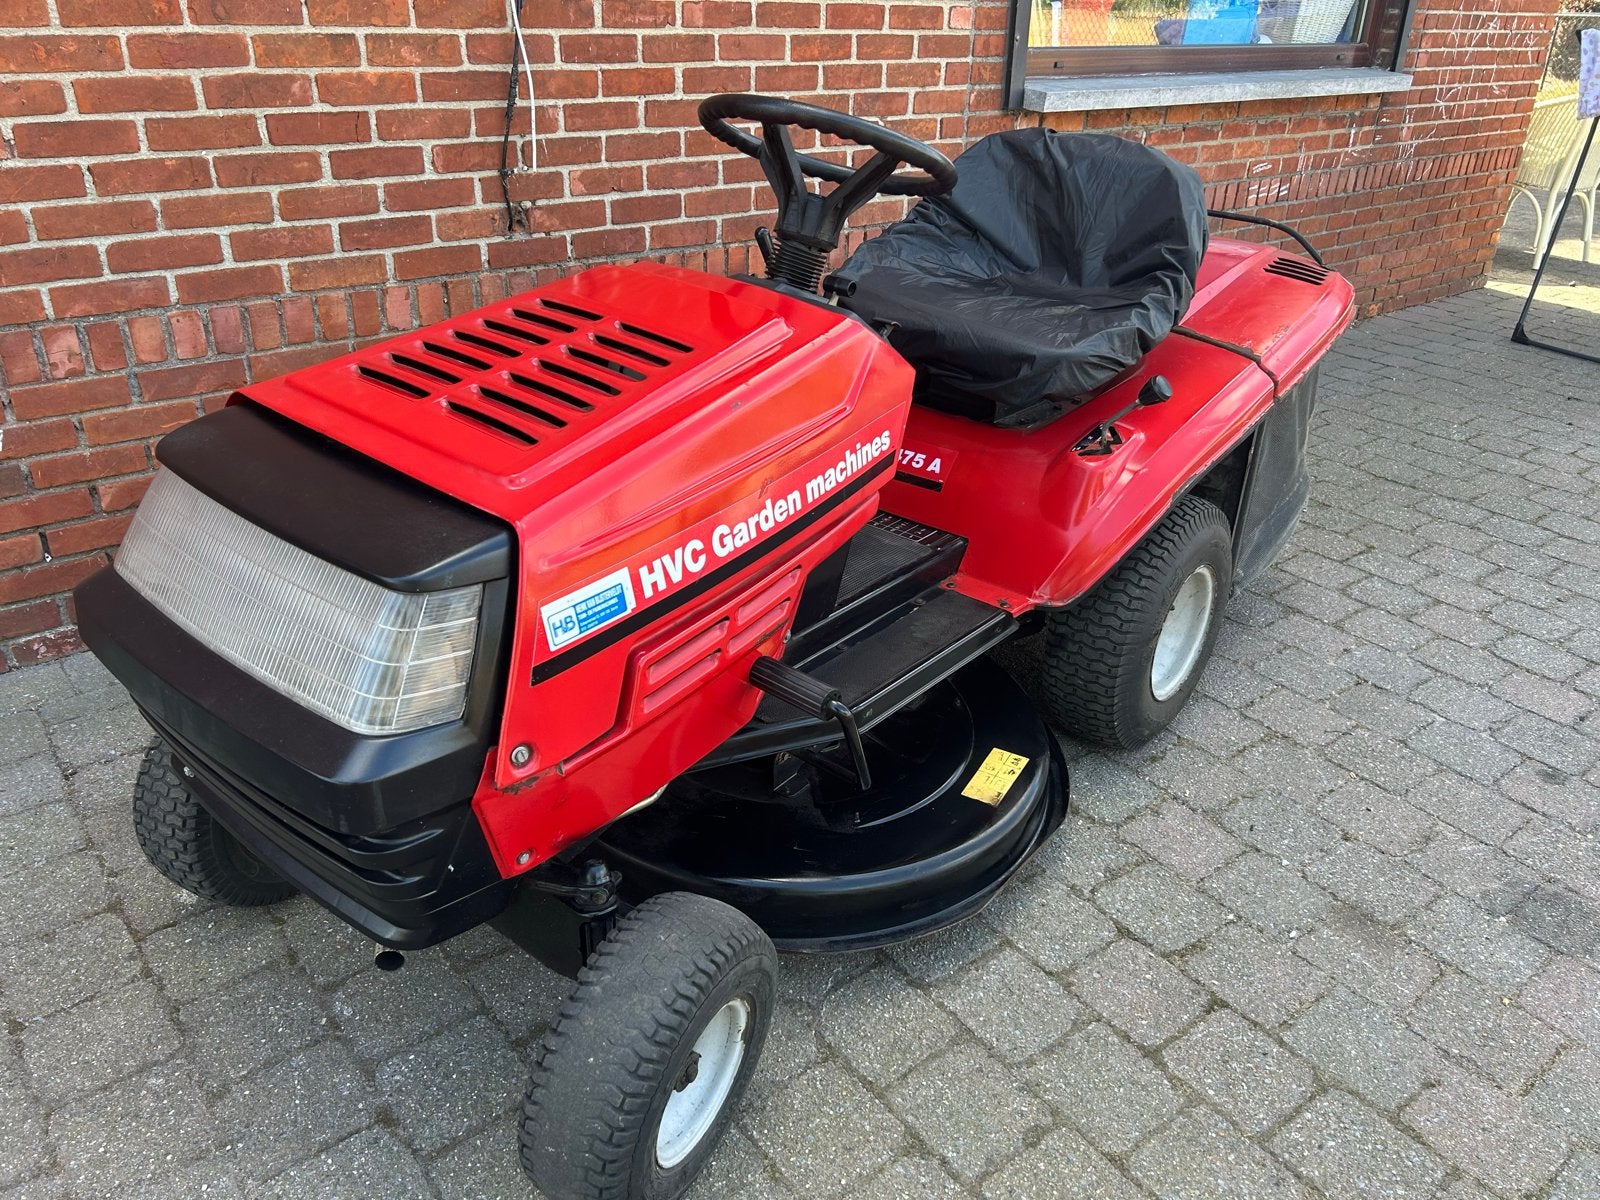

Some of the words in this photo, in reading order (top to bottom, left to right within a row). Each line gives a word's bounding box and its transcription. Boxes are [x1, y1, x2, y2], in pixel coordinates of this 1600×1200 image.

[926, 457, 941, 474] A
[639, 539, 706, 599] HVC
[712, 490, 802, 557] Garden
[805, 430, 891, 503] machines
